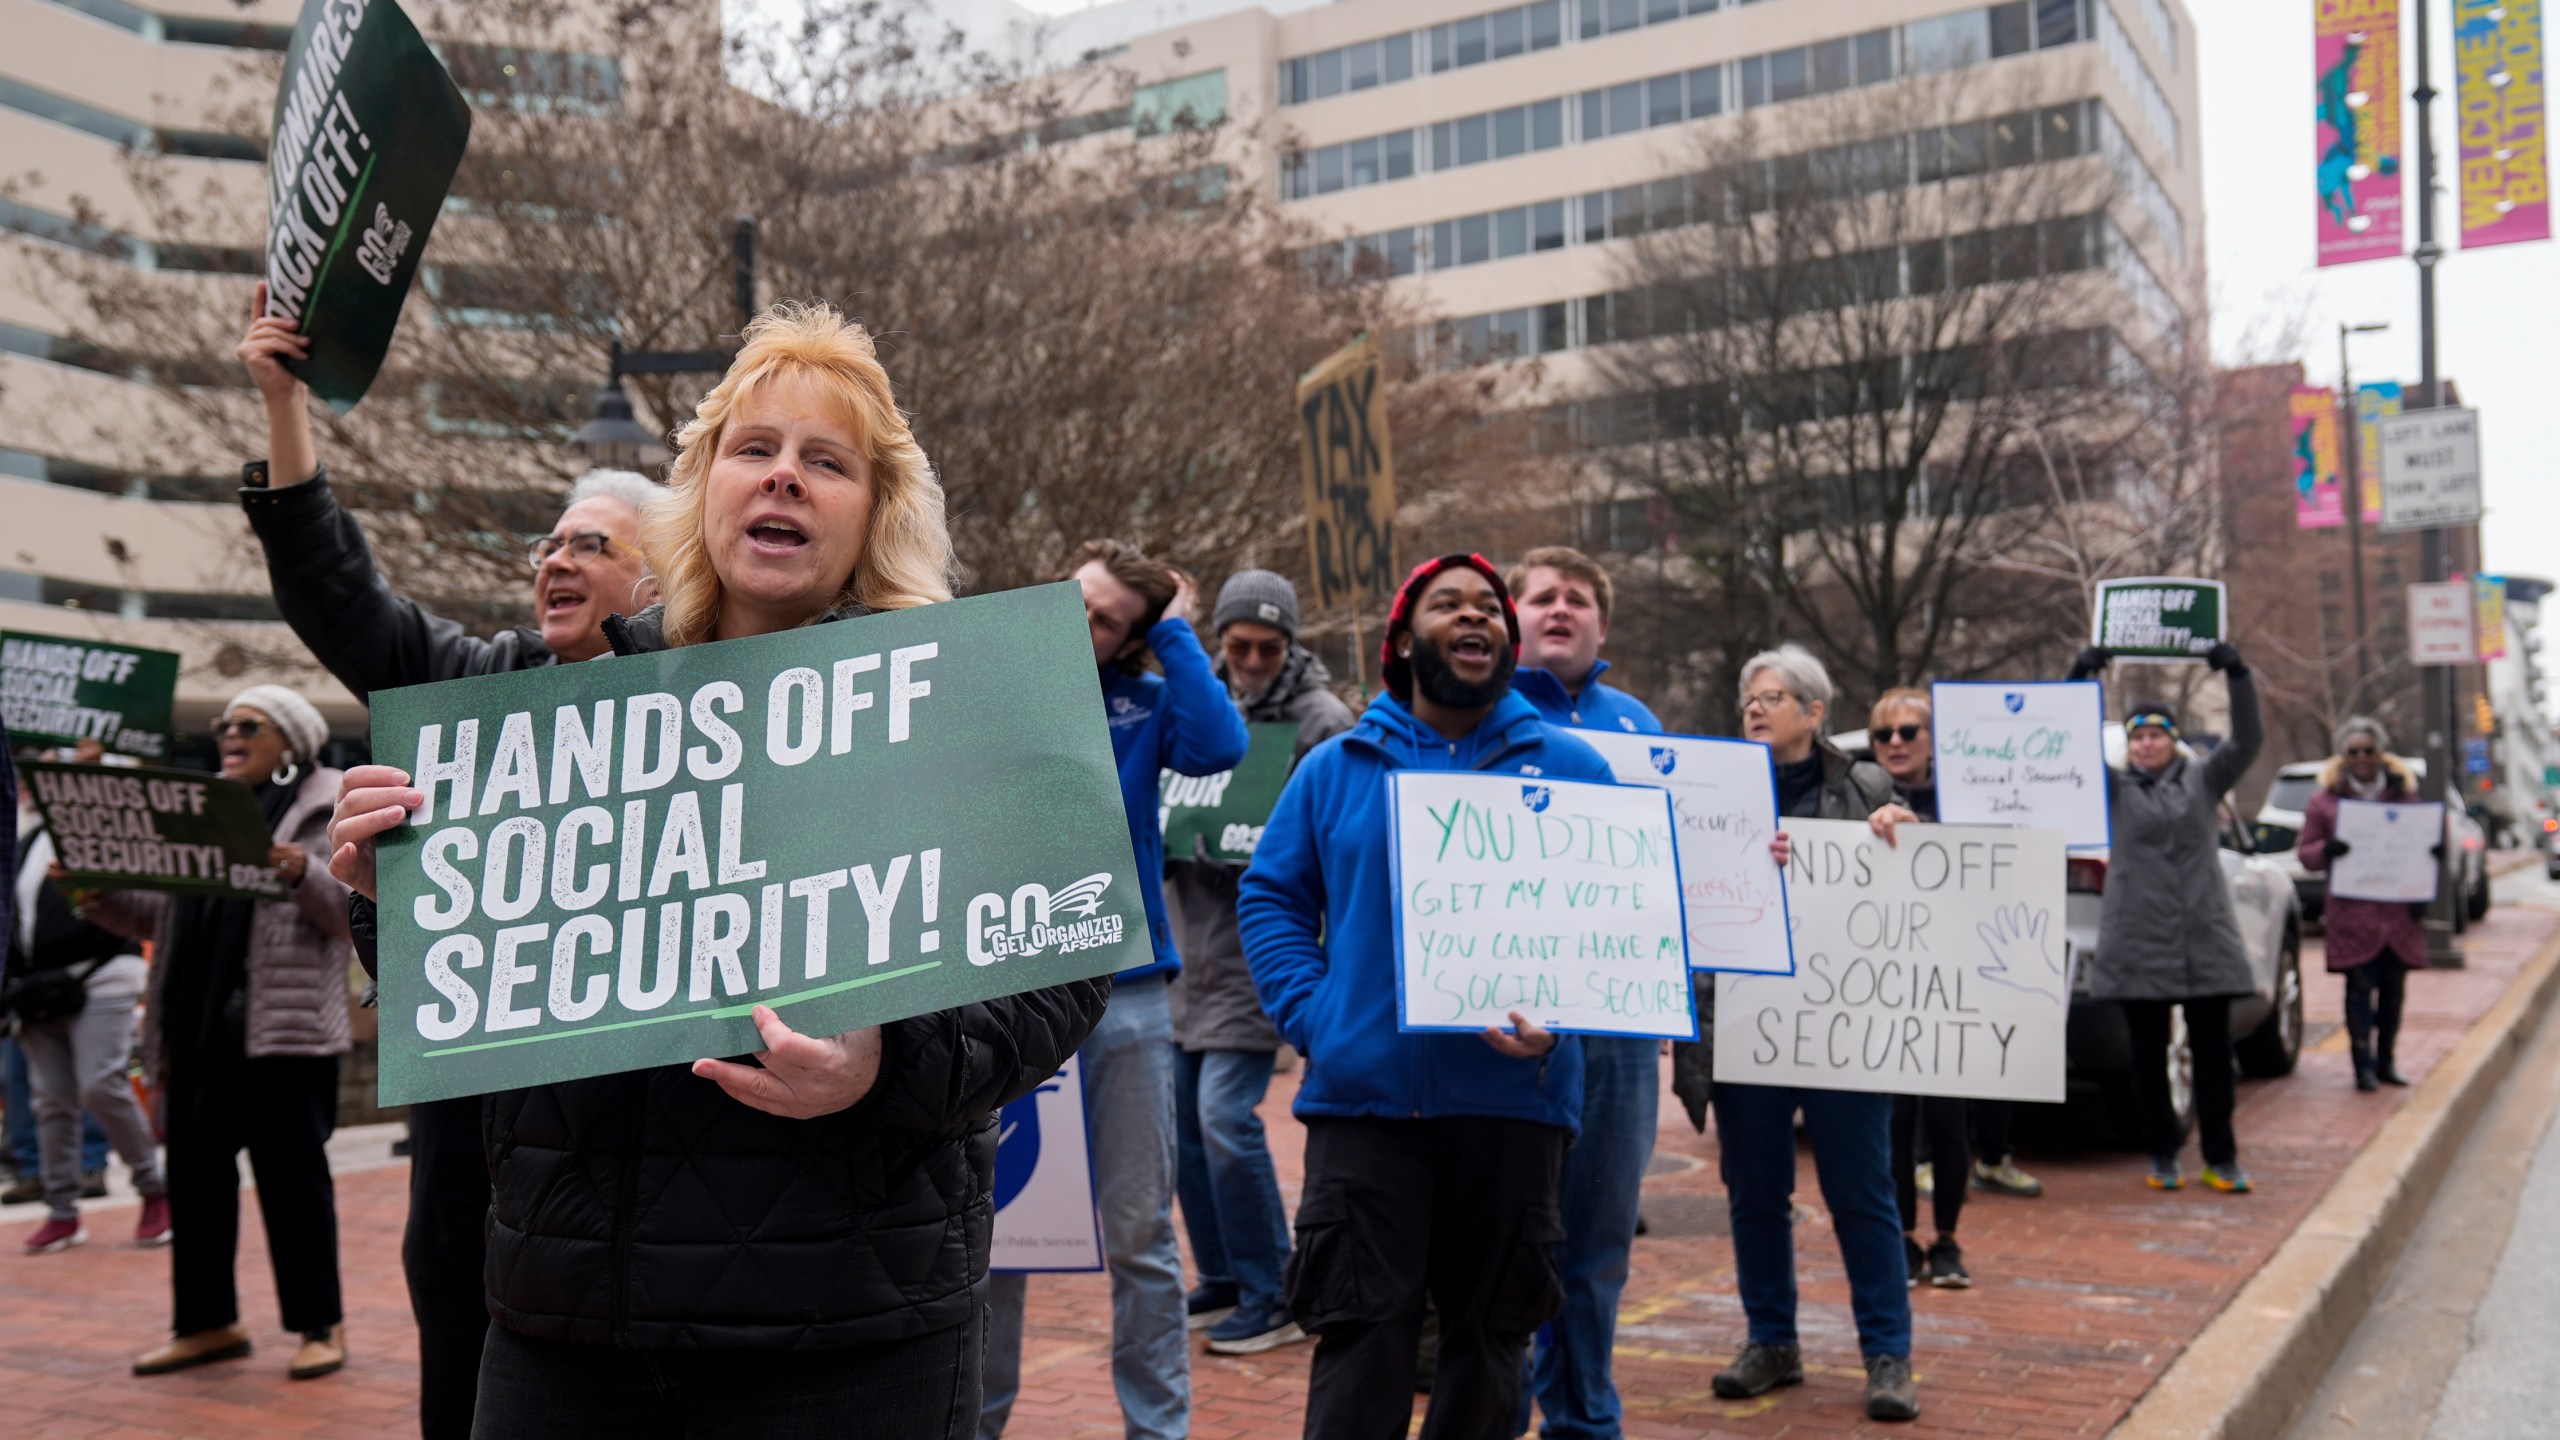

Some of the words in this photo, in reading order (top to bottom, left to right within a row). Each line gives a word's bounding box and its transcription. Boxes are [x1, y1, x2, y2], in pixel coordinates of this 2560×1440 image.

[2457, 31, 2505, 231] WELCOME
[301, 89, 371, 227] OFF!
[1303, 365, 1381, 500] TAX
[2162, 588, 2198, 612] OFF
[1, 638, 84, 677] HANDS
[81, 649, 141, 685] OFF
[411, 680, 744, 826] HANDS
[766, 642, 939, 766] OFF
[33, 770, 148, 810] HANDS
[147, 778, 208, 815] OFF
[47, 802, 165, 841] SOCIAL
[1427, 798, 1515, 863] YOU
[1674, 797, 1762, 856] Security
[59, 837, 226, 879] SECURITY!
[413, 783, 767, 931] SOCIAL
[1789, 839, 1873, 888] NDS
[1911, 840, 2018, 892] OFF
[1411, 879, 1488, 916] GET
[1506, 877, 1546, 911] MY
[1565, 880, 1648, 911] VOTE
[416, 847, 942, 1041] SECURITY!
[966, 882, 1050, 966] GO
[991, 929, 1026, 958] GET
[1031, 913, 1123, 949] ORGANIZED
[1058, 930, 1123, 955] AFSCME
[1847, 900, 1931, 952] OUR
[1418, 929, 1475, 977] YOU
[1491, 932, 1566, 961] CANT
[1578, 931, 1645, 960] HAVE
[1656, 935, 1681, 970] MY
[1434, 970, 1580, 1021] SOCIAL
[1803, 952, 1981, 1013] SOCIAL
[1753, 1007, 2016, 1077] SECURITY
